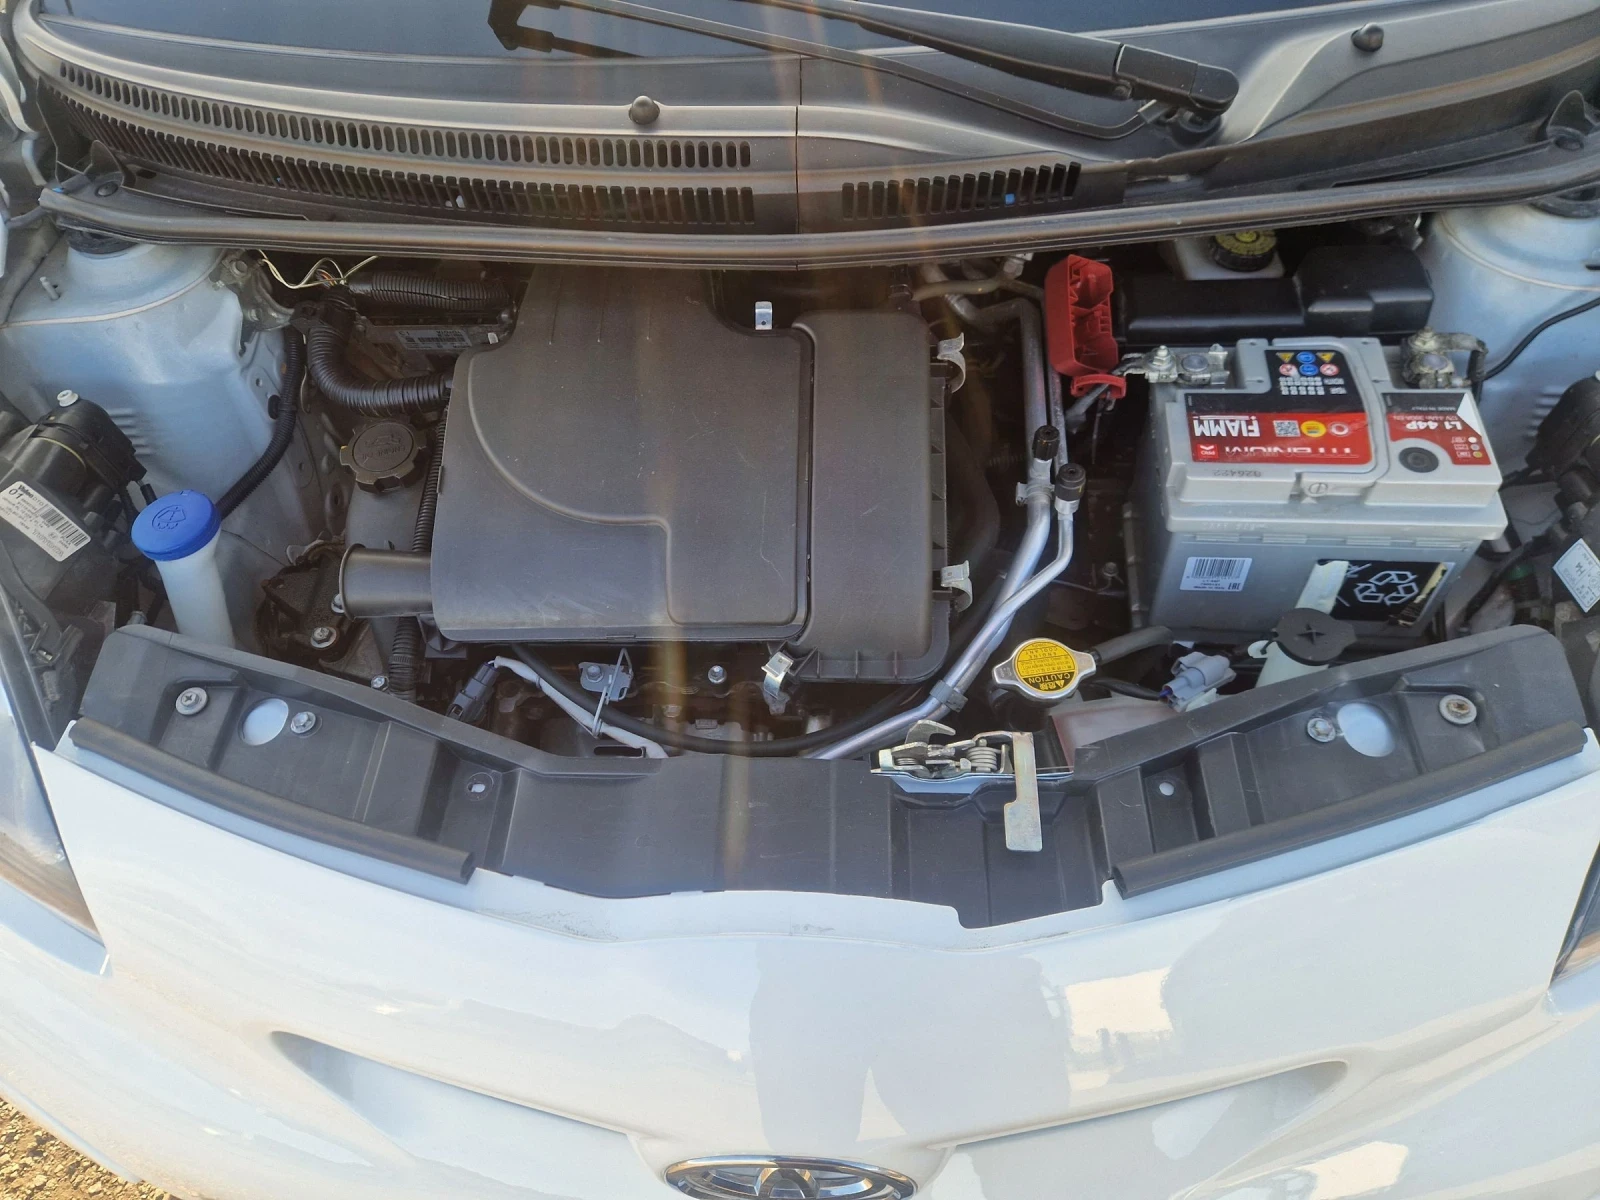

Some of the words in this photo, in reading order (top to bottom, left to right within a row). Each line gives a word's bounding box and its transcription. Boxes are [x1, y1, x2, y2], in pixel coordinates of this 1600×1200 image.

[1193, 418, 1261, 438] FIAMM
[1405, 421, 1439, 430] 44P
[1444, 421, 1464, 430] L1
[8, 488, 23, 499] 01
[1028, 672, 1071, 684] CAUTION
